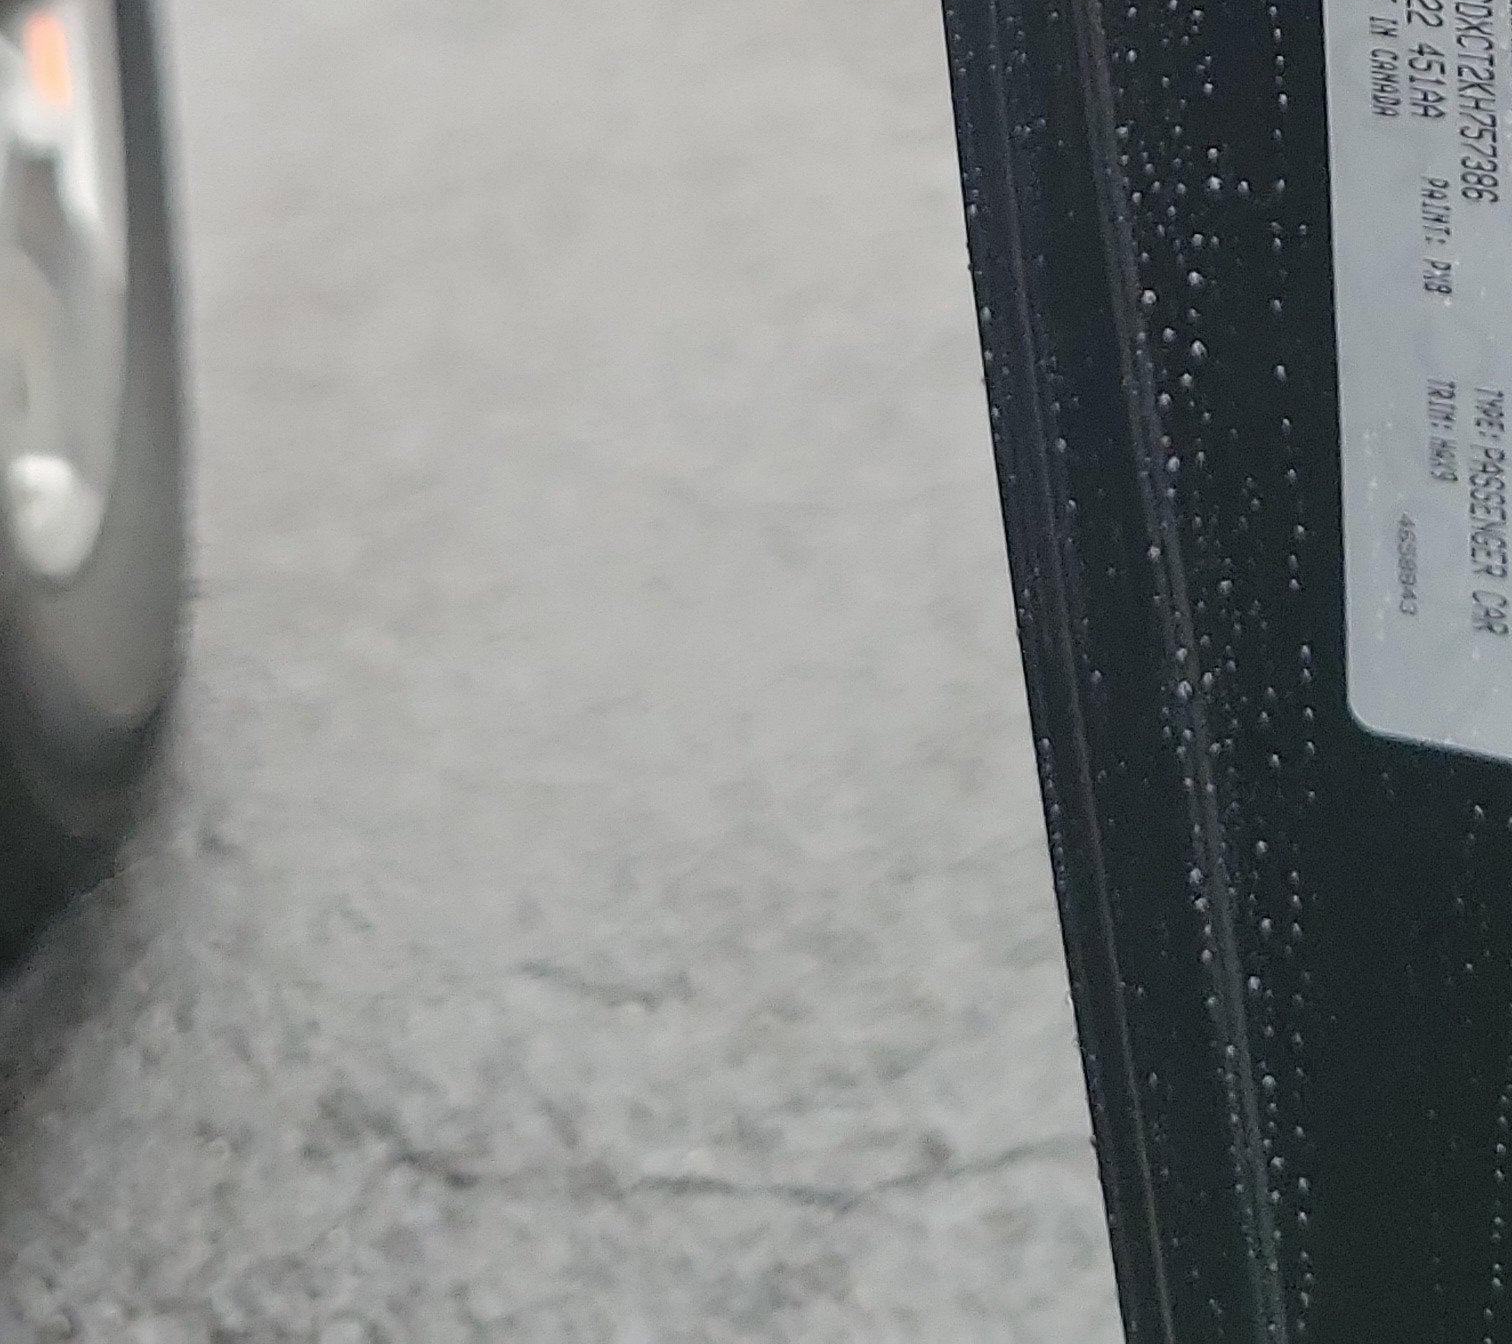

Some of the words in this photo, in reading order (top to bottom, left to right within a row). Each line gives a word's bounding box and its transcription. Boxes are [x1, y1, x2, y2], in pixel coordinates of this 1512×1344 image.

[1370, 16, 1398, 38] IN
[1371, 49, 1401, 117] CANADA
[1408, 44, 1446, 119] 451AA
[1422, 178, 1450, 244] PAINT:
[1427, 381, 1456, 430] TRIM:
[1475, 388, 1504, 439] TYPE:
[1469, 447, 1507, 578] PASSENGER
[1472, 591, 1509, 636] CAR
